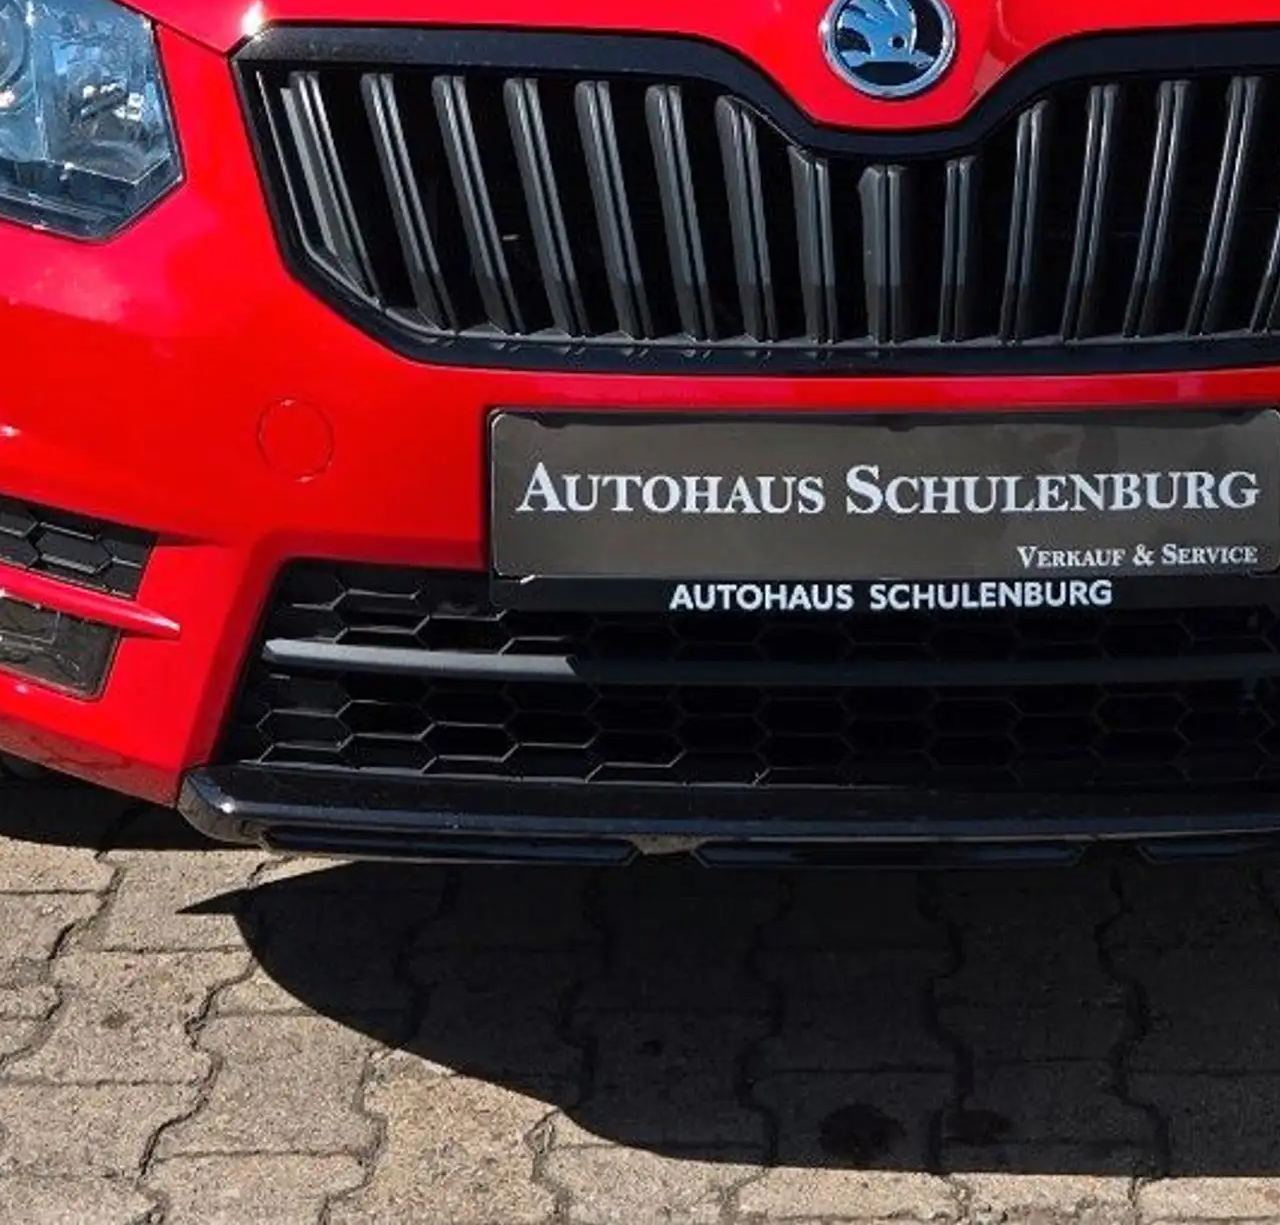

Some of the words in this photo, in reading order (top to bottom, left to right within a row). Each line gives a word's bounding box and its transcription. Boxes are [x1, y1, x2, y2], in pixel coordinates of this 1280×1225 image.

[515, 461, 826, 515] AUTOHAUS
[846, 463, 1258, 515] SCHULENBURG
[1016, 544, 1125, 567] VERKAUF
[1132, 543, 1154, 565] &
[1162, 542, 1258, 565] SERVICE
[669, 583, 854, 611] AUTOHAUS
[870, 579, 1113, 610] SCHULENBURG
